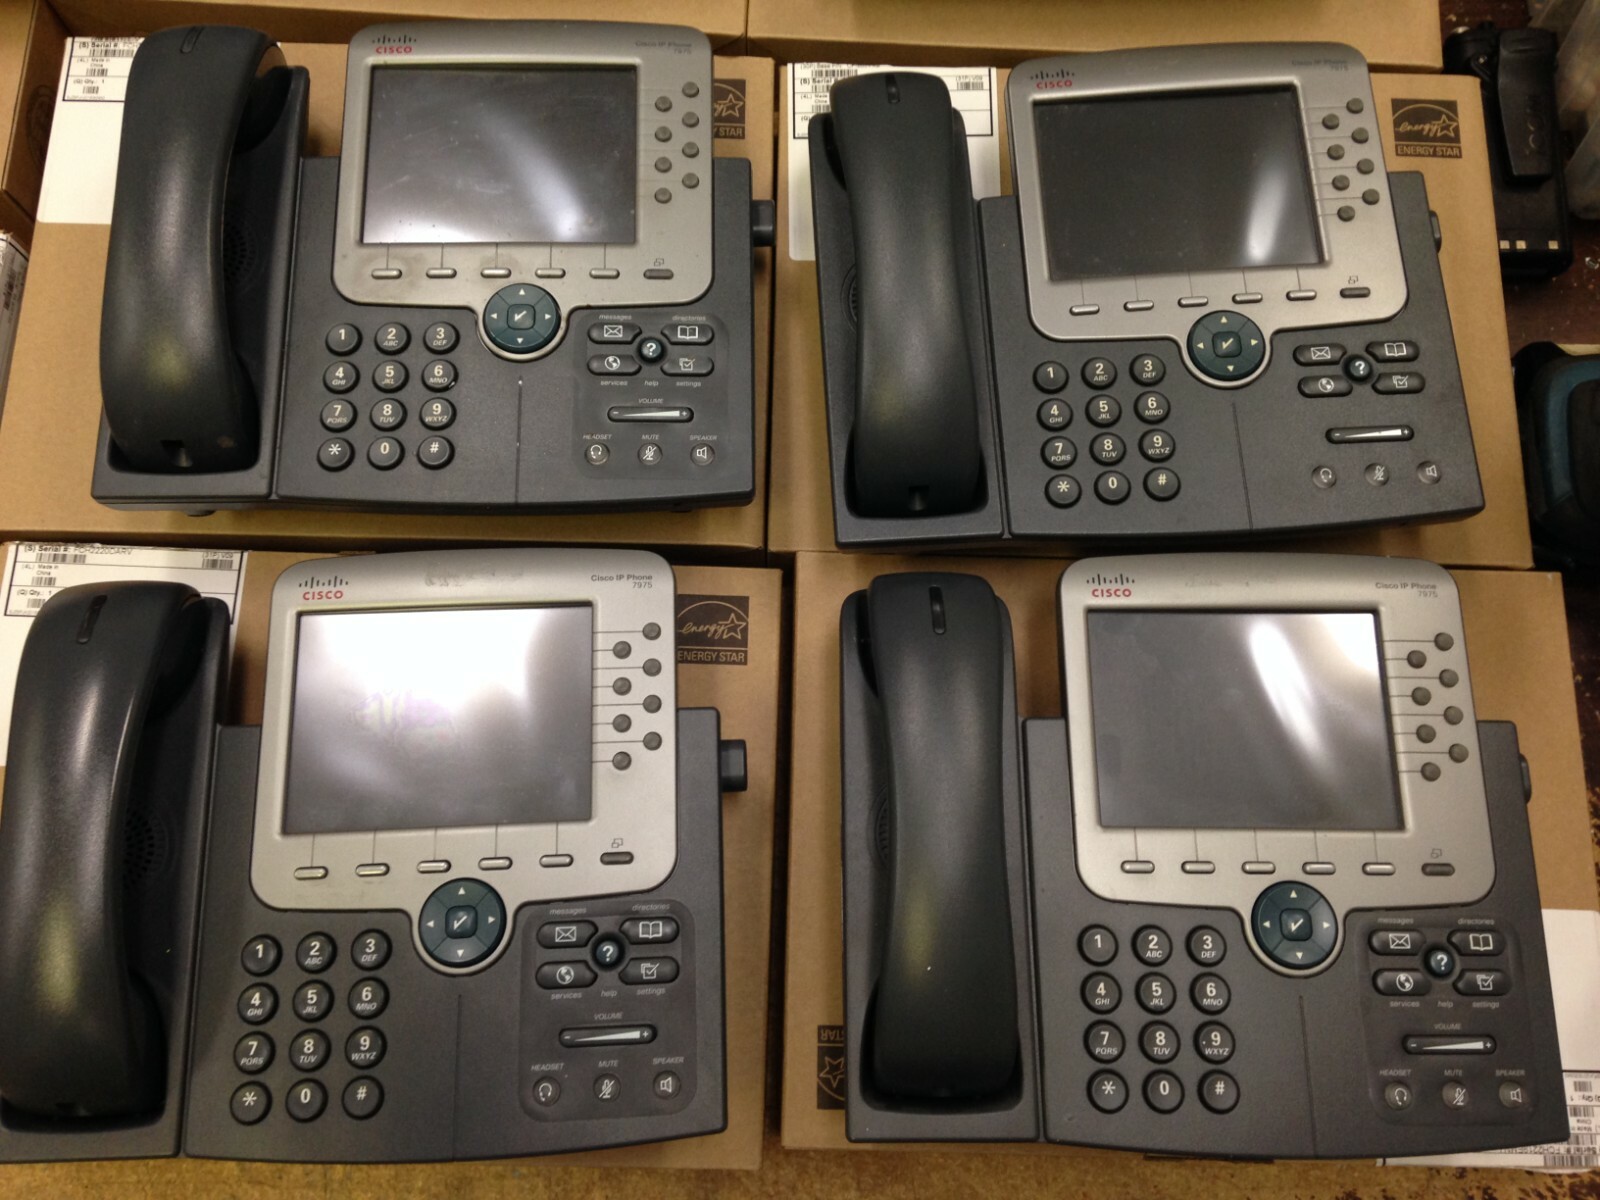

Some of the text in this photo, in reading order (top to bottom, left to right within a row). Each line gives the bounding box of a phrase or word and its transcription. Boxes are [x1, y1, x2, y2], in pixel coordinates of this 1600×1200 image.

[376, 46, 412, 54] CISCO
[1036, 79, 1073, 89] CISCO
[719, 127, 742, 136] STAR
[1398, 146, 1460, 156] ENERGY STAR
[338, 329, 345, 340] 1
[387, 328, 396, 339] 2
[436, 327, 445, 339] 3
[646, 342, 656, 355] ?
[434, 365, 443, 376] 6
[1095, 363, 1104, 375] 2
[1144, 360, 1152, 371] 3
[1355, 361, 1366, 374] ?
[335, 367, 344, 378] 4
[385, 366, 394, 377] 5
[1047, 368, 1054, 378] 1
[1099, 401, 1109, 412] 5
[1148, 397, 1157, 409] 6
[333, 405, 342, 416] 7
[383, 404, 392, 415] 8
[432, 403, 441, 415] 9
[1051, 405, 1059, 416] 4
[1103, 440, 1113, 450] 8
[1153, 436, 1162, 447] 9
[380, 442, 389, 454] 0
[430, 442, 439, 453] #
[1055, 443, 1063, 454] 7
[1108, 477, 1118, 489] 0
[1158, 474, 1167, 485] #
[303, 590, 344, 600] CISCO
[1092, 588, 1132, 598] CISCO
[678, 651, 744, 662] ENERGY STAR
[550, 906, 587, 916] messages
[632, 903, 670, 911] directories
[1378, 917, 1414, 925] messages
[365, 939, 375, 953] 3
[1094, 935, 1102, 948] 1
[1148, 935, 1158, 948] 2
[1203, 936, 1212, 949] 3
[256, 944, 263, 958] 1
[310, 942, 320, 956] 2
[602, 945, 614, 961] ?
[1146, 950, 1162, 958] ABC
[305, 957, 322, 965] ABC
[361, 954, 378, 962] DEF
[1437, 954, 1448, 970] ?
[362, 987, 372, 1001] 6
[601, 990, 617, 998] help
[636, 987, 666, 996] settings
[1097, 982, 1106, 996] 4
[1151, 982, 1161, 996] 5
[1206, 982, 1216, 997] 6
[251, 992, 261, 1006] 4
[307, 990, 317, 1004] 5
[551, 992, 582, 1000] services
[355, 1002, 377, 1011] MNO
[1150, 998, 1164, 1006] JKL
[1438, 1000, 1454, 1009] help
[1472, 1001, 1500, 1009] settings
[248, 1008, 262, 1016] GHI
[303, 1006, 318, 1014] JKL
[594, 1012, 623, 1020] VOLUME
[360, 1036, 370, 1050] 9
[1100, 1031, 1110, 1045] 7
[1155, 1031, 1166, 1045] 8
[1211, 1031, 1221, 1045] 9
[248, 1041, 258, 1055] 7
[304, 1039, 314, 1053] 8
[300, 1055, 317, 1063] TUV
[351, 1052, 377, 1061] WXYZ
[652, 1056, 684, 1064] SPEAKER
[531, 1063, 564, 1071] HEADSET
[356, 1086, 367, 1100] #
[1160, 1080, 1170, 1095] 0
[1215, 1081, 1225, 1095] #
[301, 1088, 310, 1103] 0
[1574, 1147, 1597, 1155] Serial
